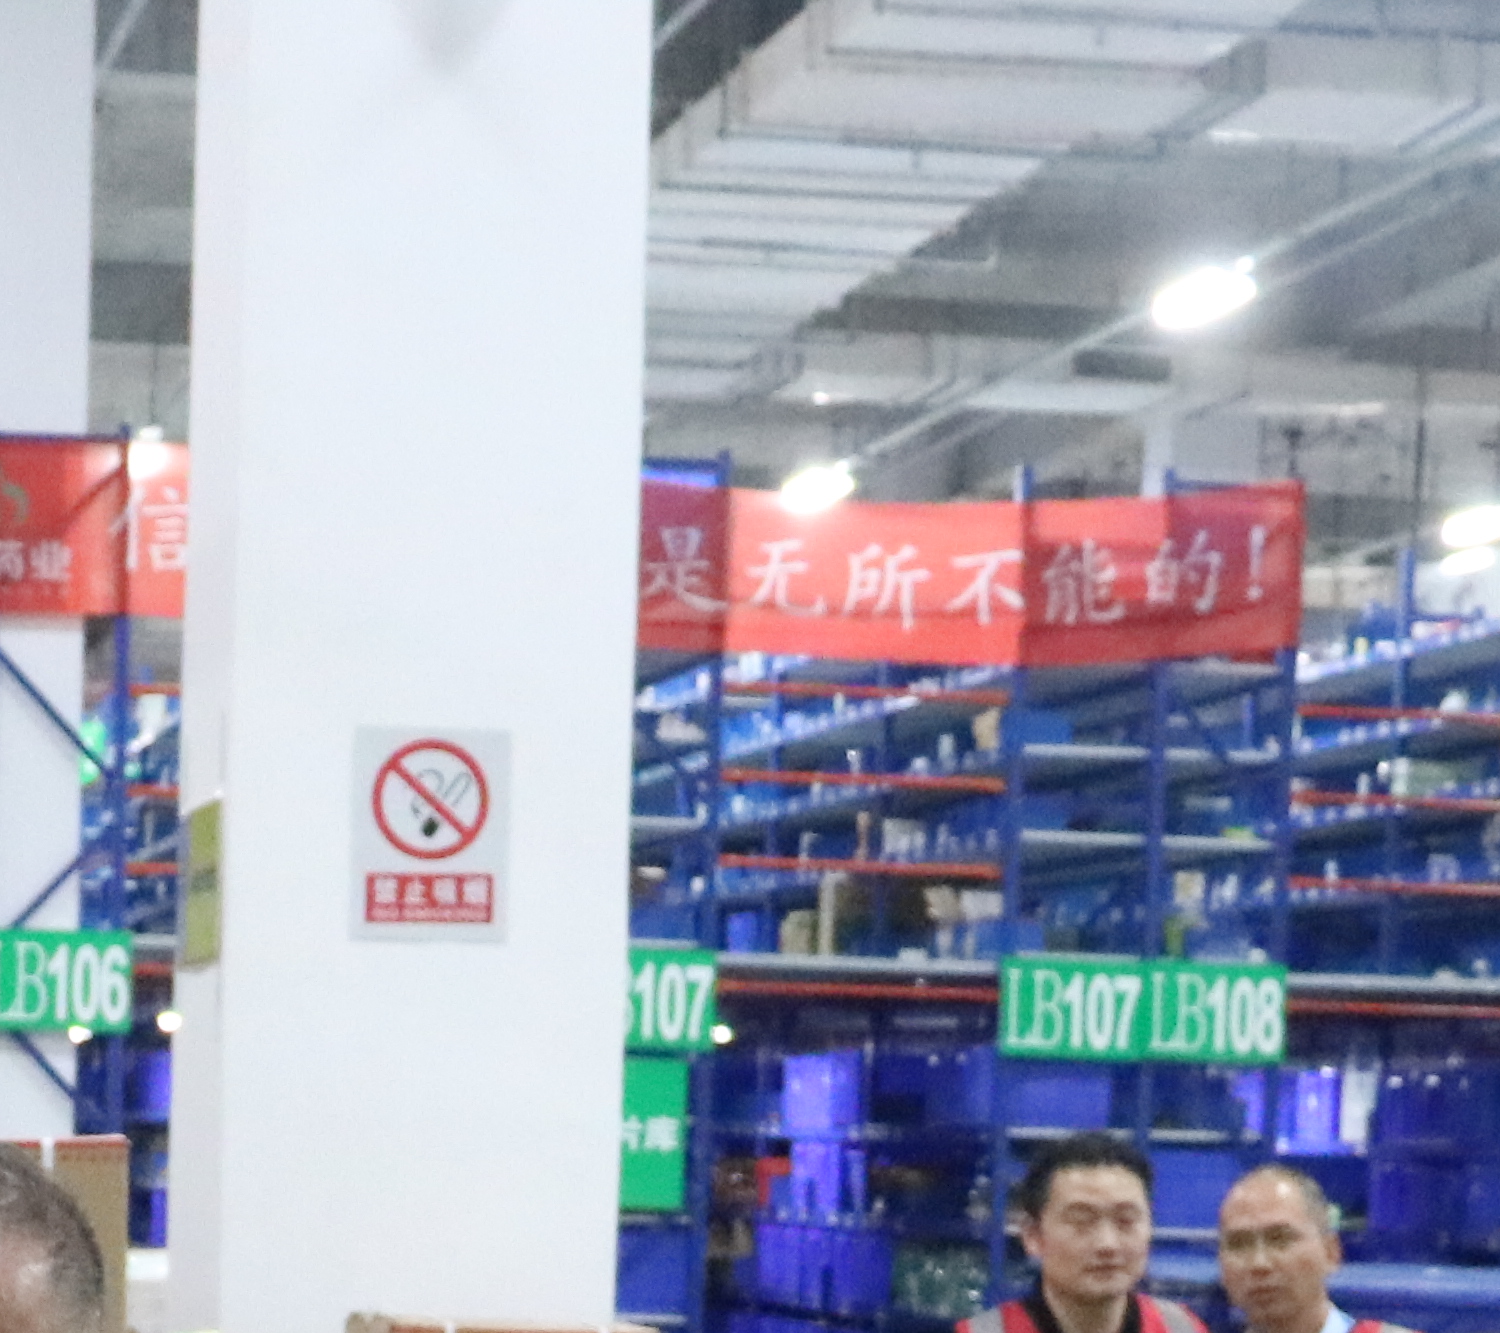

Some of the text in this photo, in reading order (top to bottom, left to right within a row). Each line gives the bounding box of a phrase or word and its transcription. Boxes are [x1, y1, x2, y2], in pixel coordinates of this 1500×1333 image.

[625, 959, 714, 1043] 107
[1006, 968, 1284, 1056] LB107 LB108
